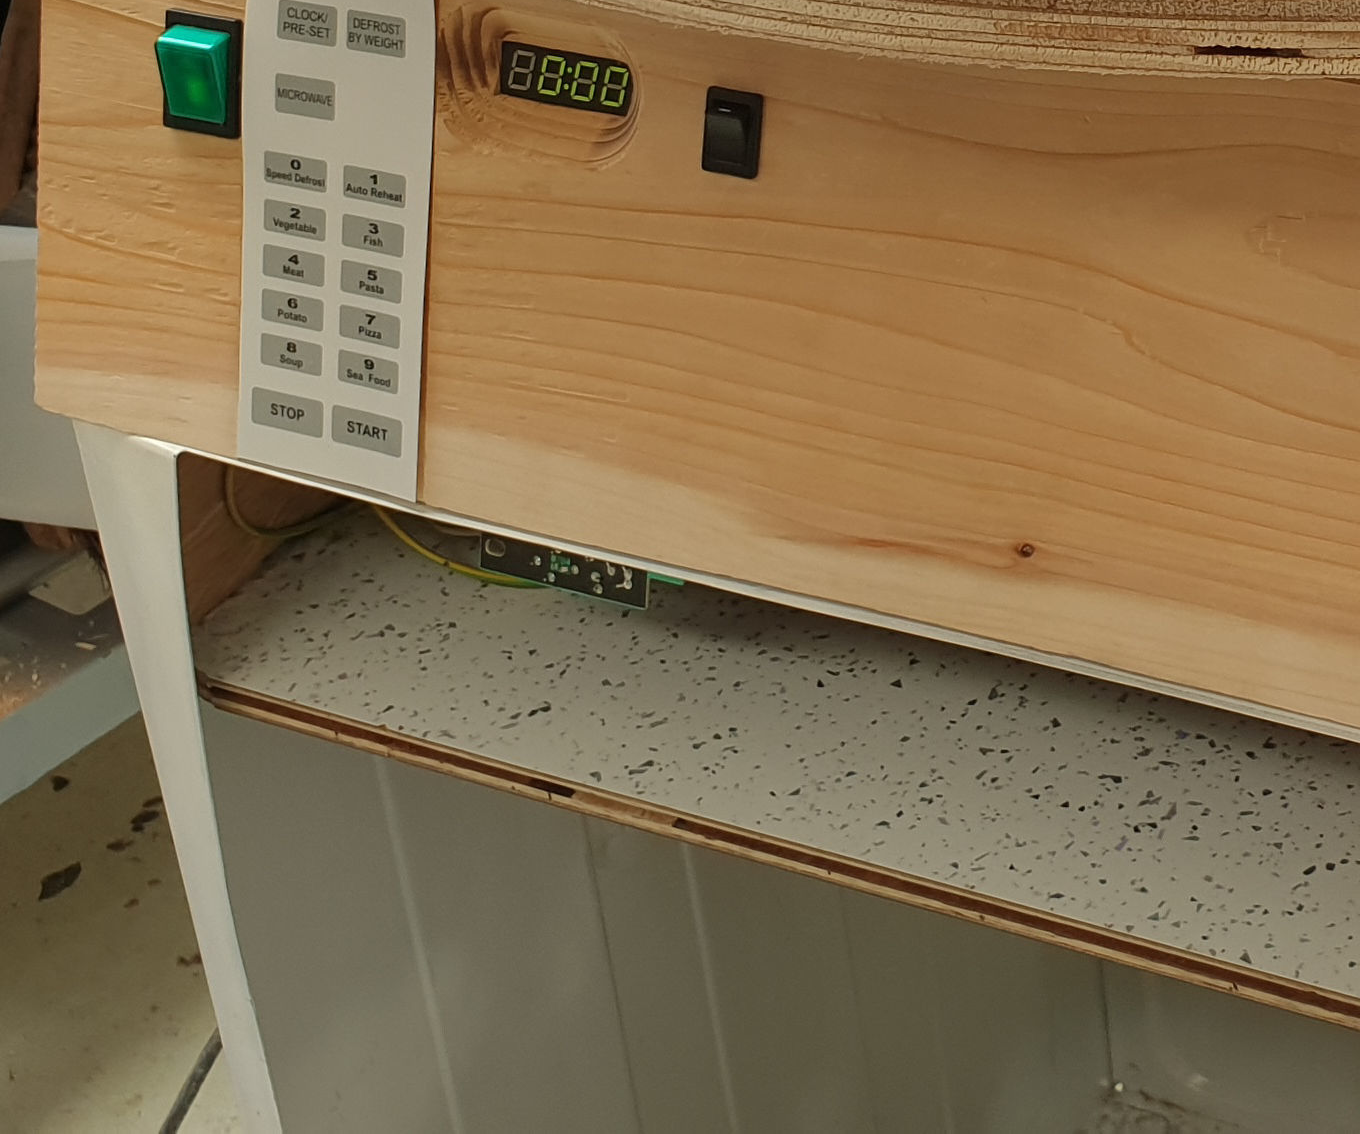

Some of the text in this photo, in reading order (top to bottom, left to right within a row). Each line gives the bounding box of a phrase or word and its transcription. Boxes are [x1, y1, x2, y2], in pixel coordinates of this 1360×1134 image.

[287, 7, 328, 24] CLOCK/
[283, 23, 330, 38] PRE-SET
[353, 18, 401, 35] DEFROST
[348, 32, 404, 51] BY WEIGHT
[277, 87, 333, 107] MICROWAVE
[290, 159, 301, 170] 0
[266, 168, 325, 188] Speed Defrost
[369, 174, 378, 185] 1
[346, 183, 402, 203] Auto Reheat
[290, 208, 301, 219] 2
[273, 218, 317, 235] Vegetable
[368, 223, 379, 235] 3
[363, 235, 383, 248] Fish
[287, 254, 300, 266] 4
[282, 265, 304, 278] Meat
[367, 270, 378, 281] 5
[359, 281, 384, 295] Pasta
[287, 298, 298, 309] 6
[277, 309, 307, 323] Potato
[365, 314, 376, 325] 7
[358, 326, 382, 340] Pizza
[286, 342, 297, 353] 8
[280, 354, 303, 369] Soup
[363, 359, 375, 370] 9
[346, 369, 391, 387] Sea Food
[270, 404, 305, 421] STOP
[347, 421, 388, 442] START
